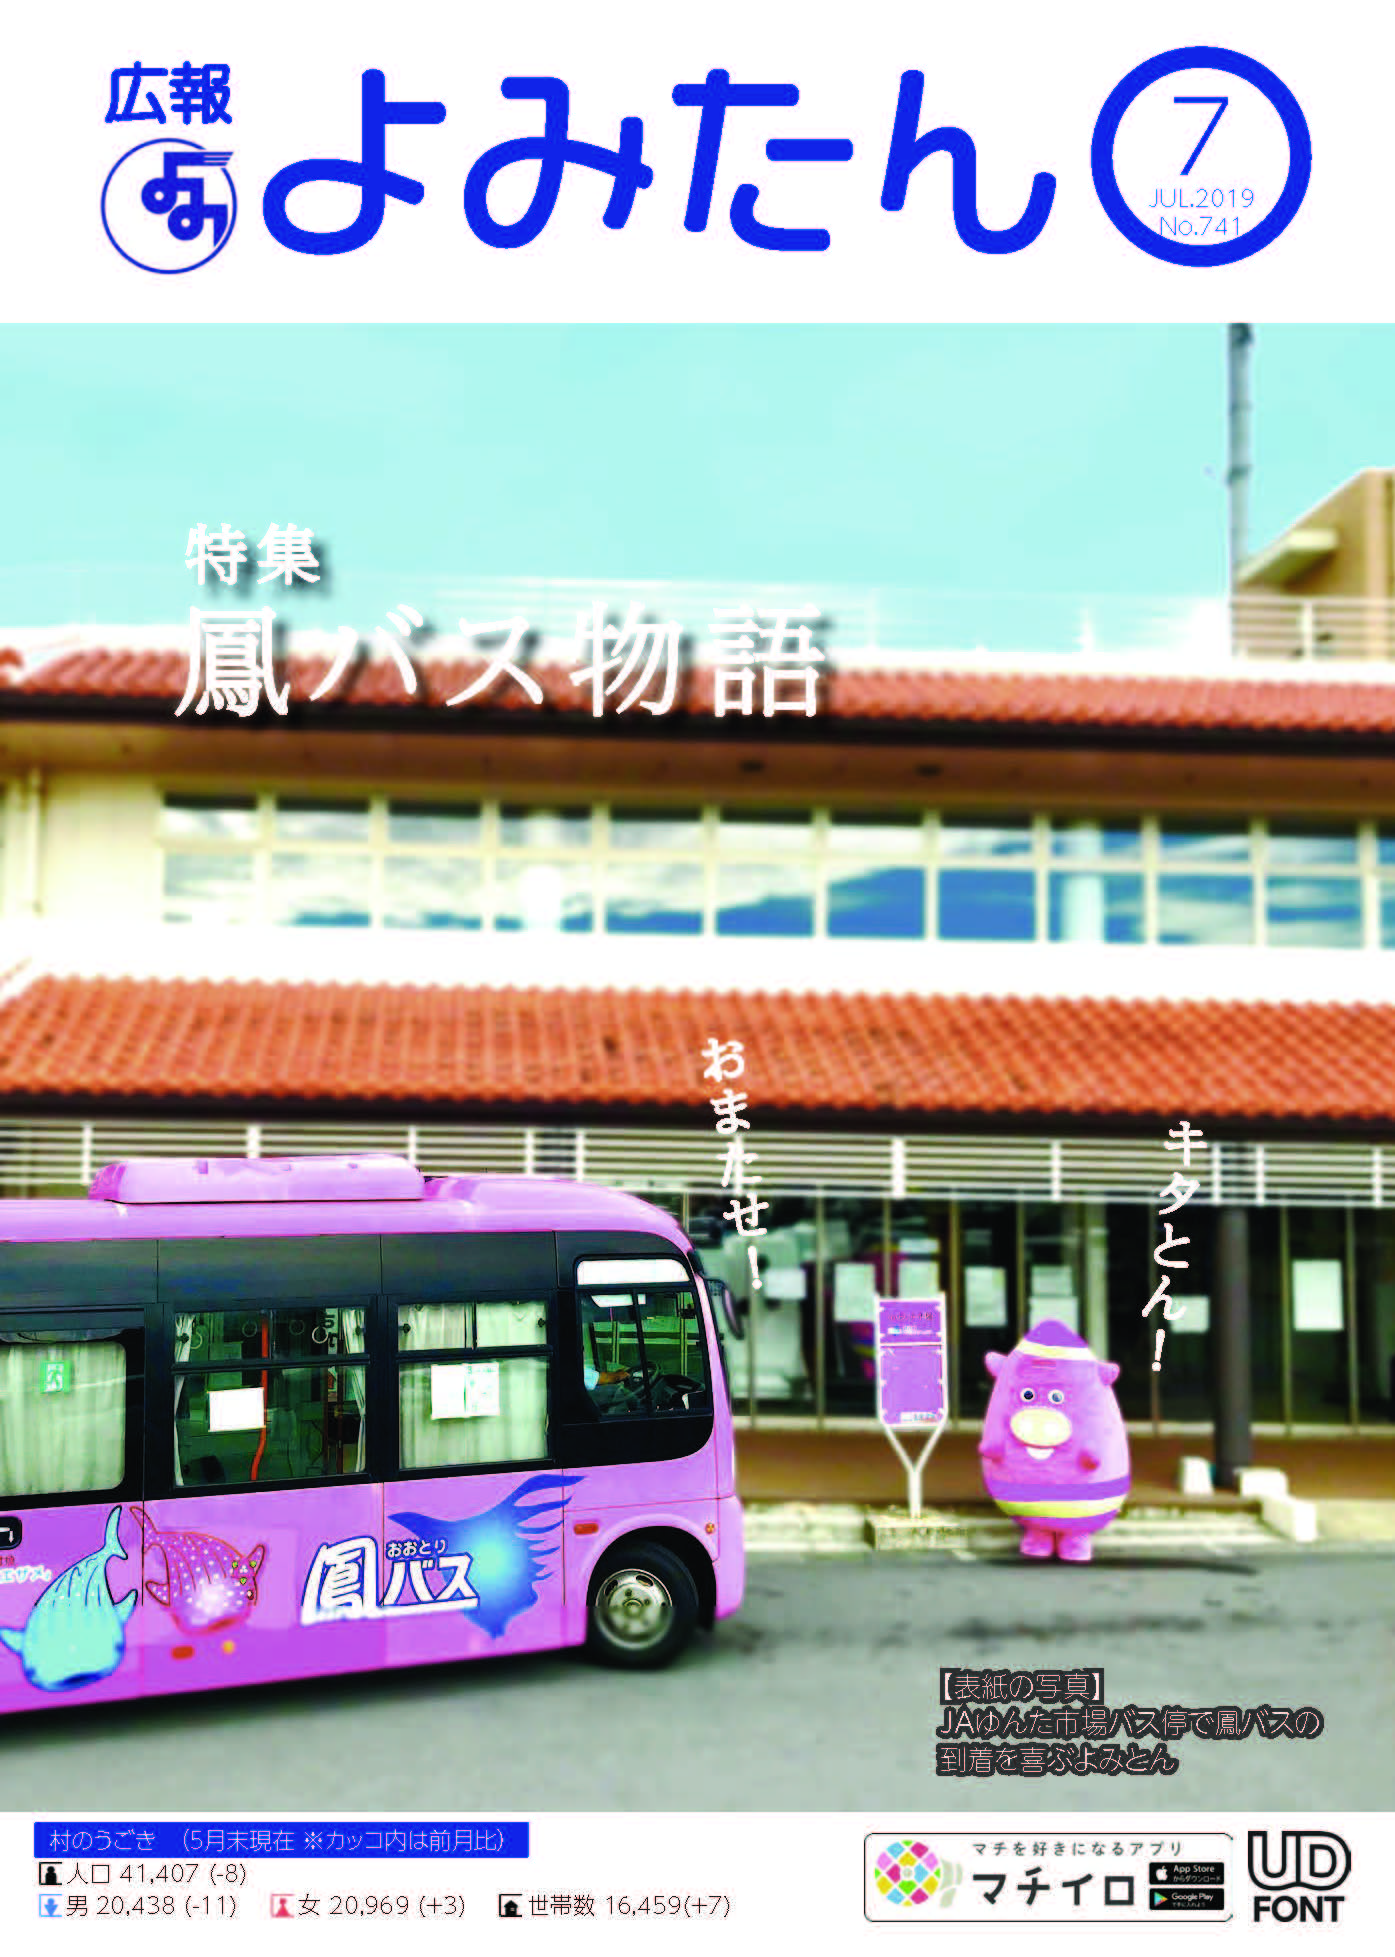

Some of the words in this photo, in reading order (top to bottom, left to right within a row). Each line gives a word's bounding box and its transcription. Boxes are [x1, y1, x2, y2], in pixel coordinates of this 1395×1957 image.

[386, 1539, 447, 1558] おおとり
[301, 1536, 479, 1627] 鳳バス
